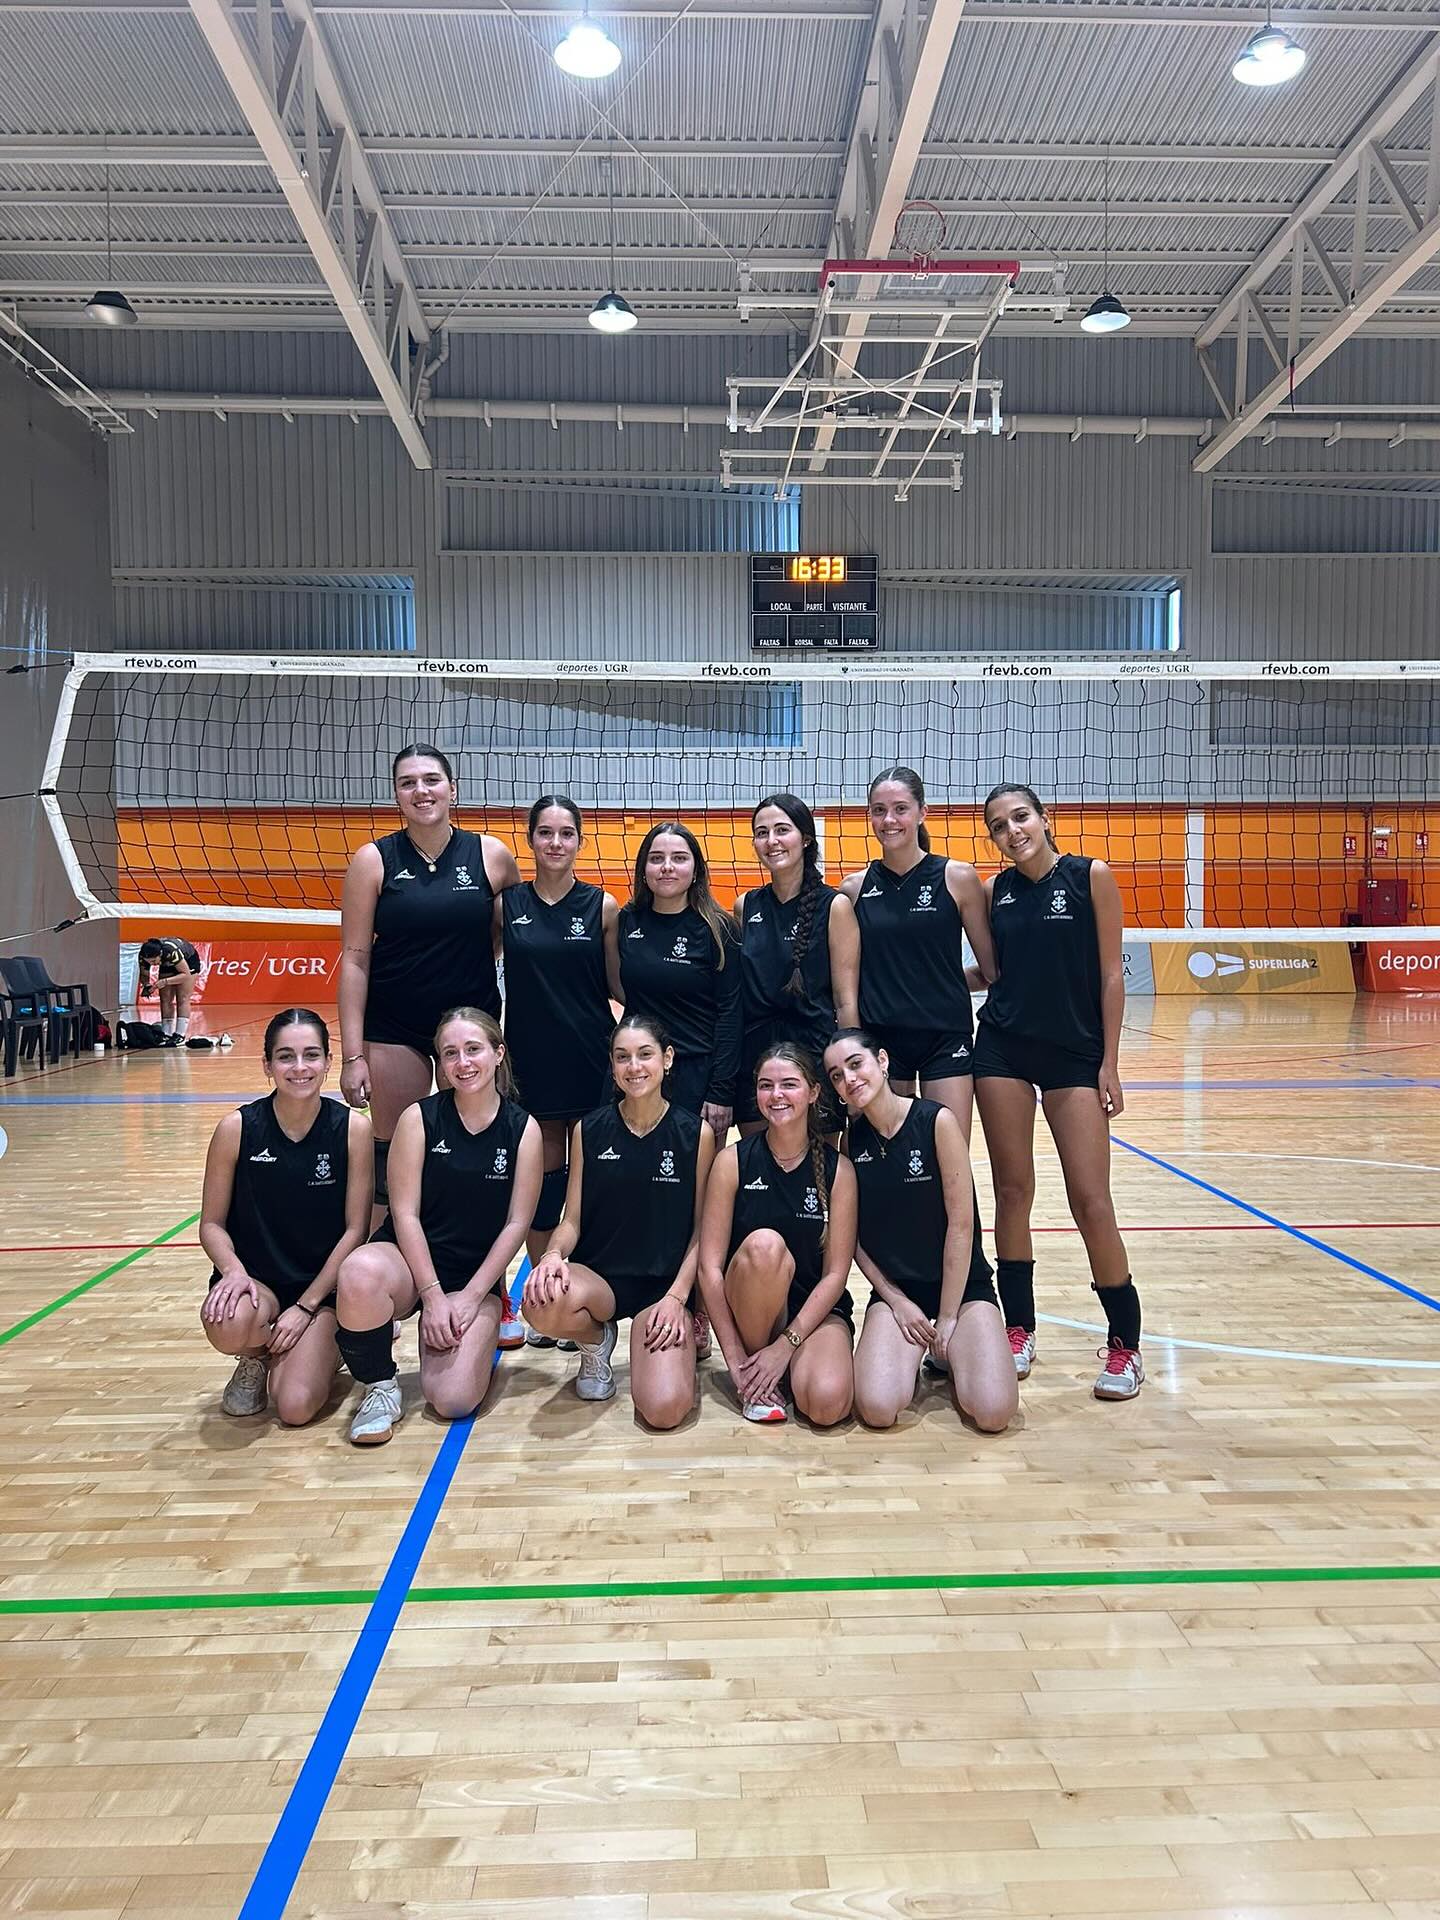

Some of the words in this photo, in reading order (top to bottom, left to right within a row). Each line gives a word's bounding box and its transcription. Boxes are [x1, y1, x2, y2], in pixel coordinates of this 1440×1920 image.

[792, 556, 845, 580] 16:33
[770, 602, 792, 611] LOCAL
[806, 603, 823, 611] PARTE
[832, 602, 868, 611] VISITANTE
[124, 657, 197, 668] rfevb.com
[417, 660, 489, 673] rfevb.com
[556, 663, 598, 674] deportes
[604, 664, 629, 673] UGR
[701, 664, 771, 676] rfevb.com
[982, 664, 1052, 676] rfevb.com
[1119, 664, 1161, 675] deportes
[1166, 665, 1190, 673] UGR
[1261, 663, 1330, 675] rfevb.com
